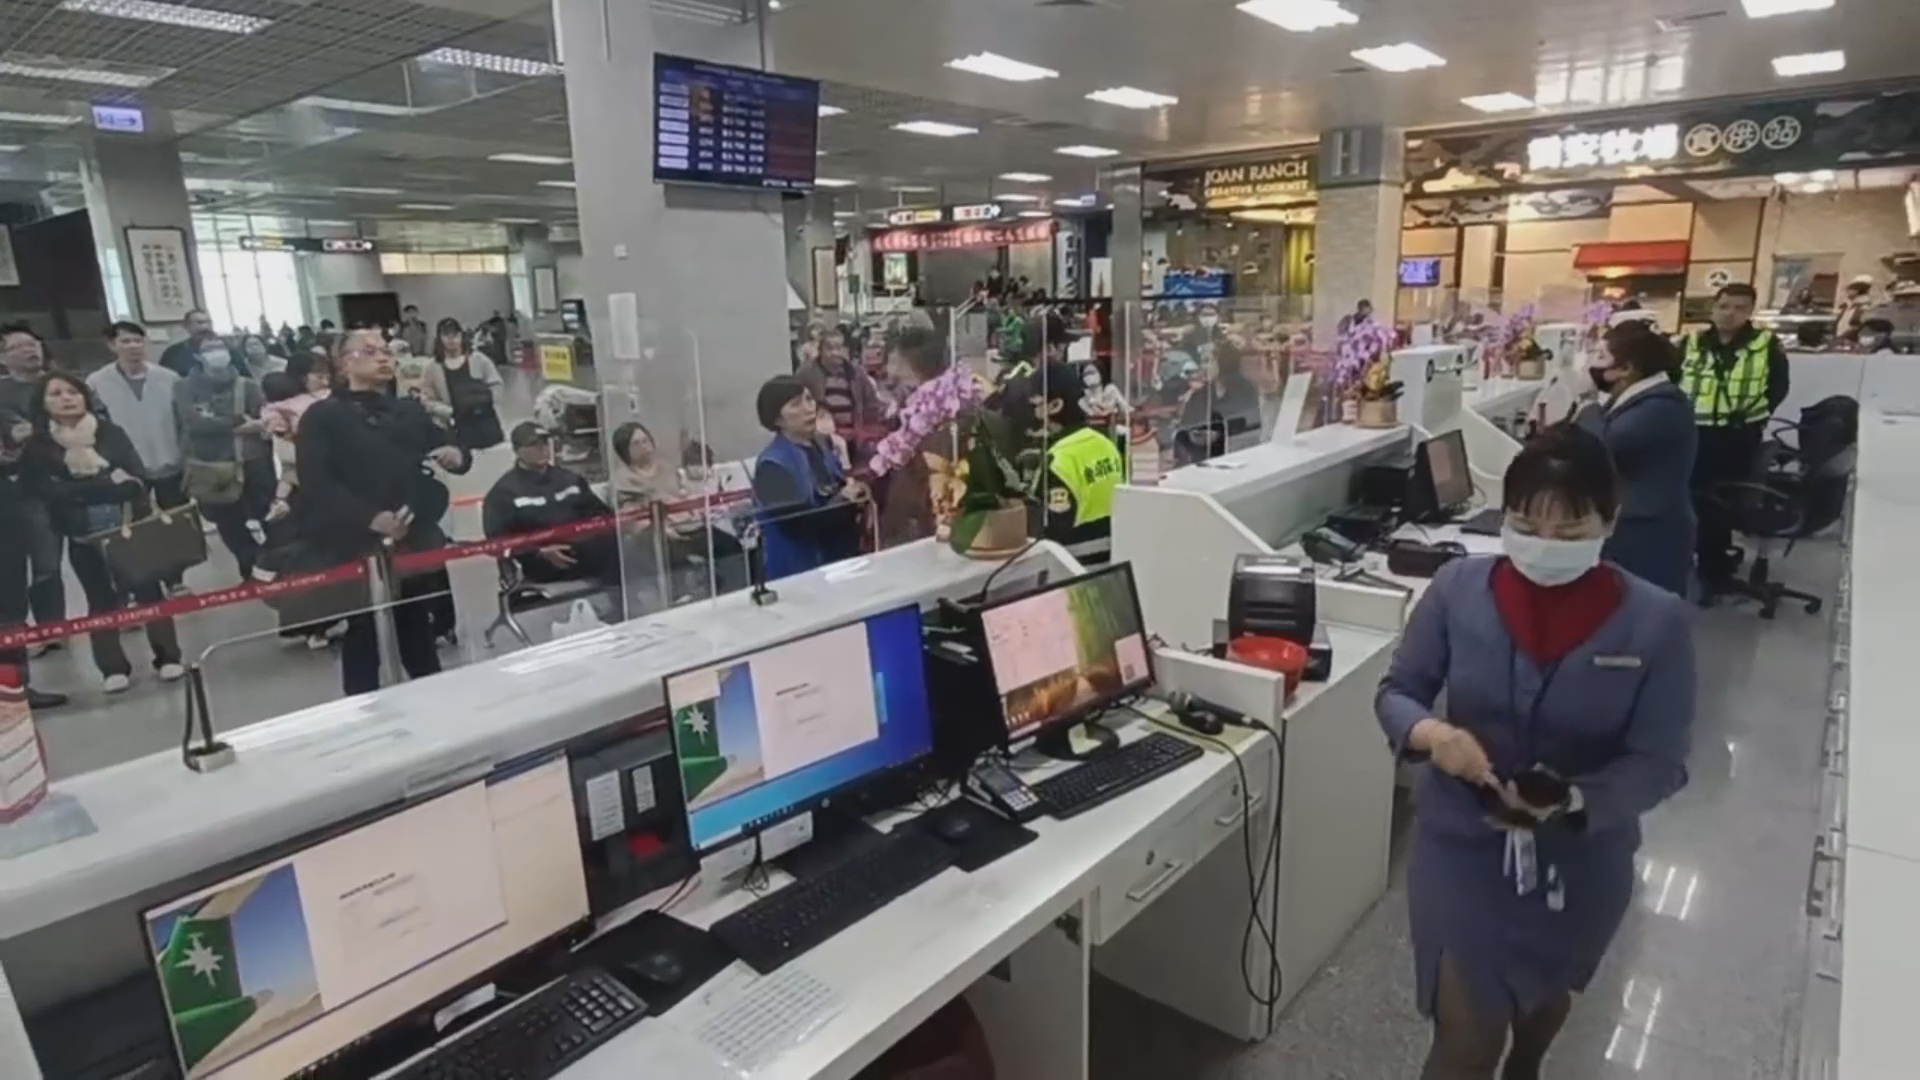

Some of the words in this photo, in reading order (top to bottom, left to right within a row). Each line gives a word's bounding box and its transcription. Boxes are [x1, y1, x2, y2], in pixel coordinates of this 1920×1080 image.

[1331, 129, 1362, 177] H
[1204, 166, 1245, 187] JOAN
[1250, 160, 1309, 181] RANCH
